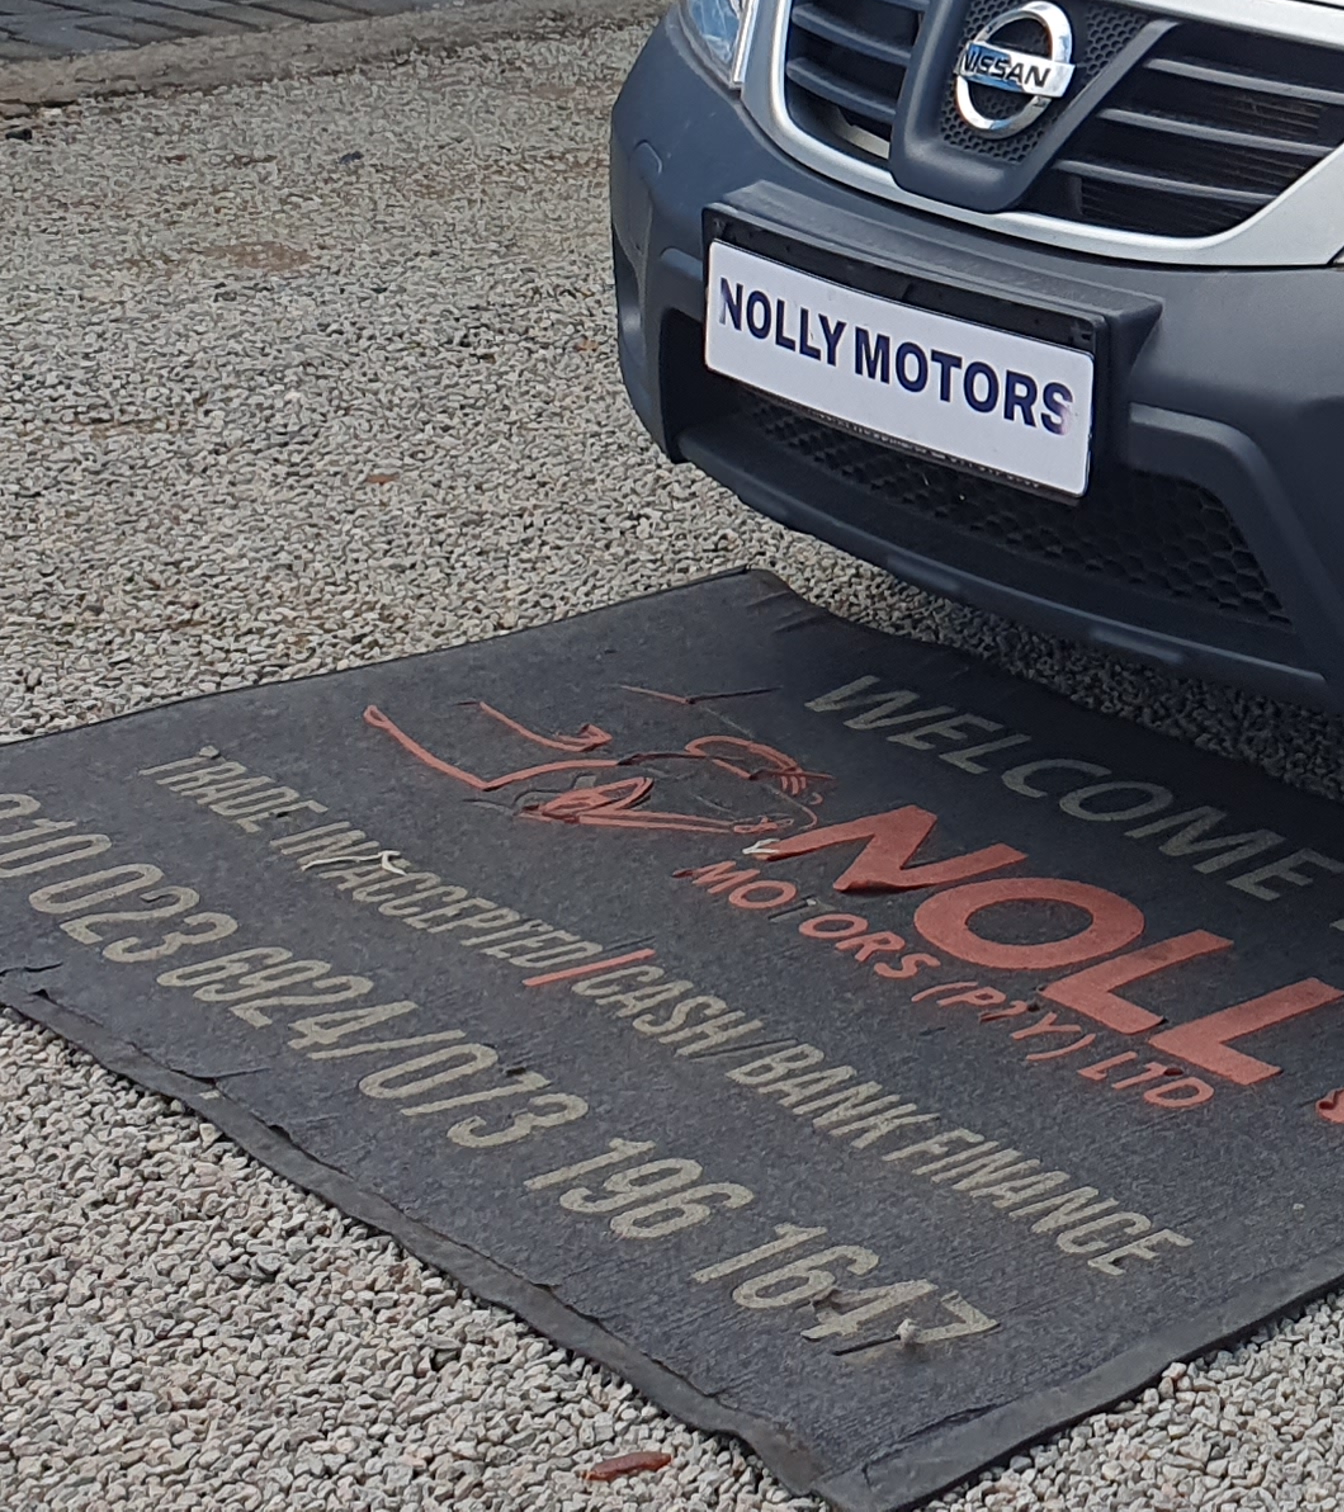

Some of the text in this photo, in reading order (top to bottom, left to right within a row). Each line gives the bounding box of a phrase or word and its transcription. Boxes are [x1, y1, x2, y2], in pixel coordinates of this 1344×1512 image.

[961, 48, 1052, 89] NISSAN
[718, 276, 1074, 437] NOLLY MOTORS
[138, 745, 329, 833] TRADE
[882, 1126, 1194, 1276] FINANCE
[1077, 1050, 1215, 1109] LTD
[524, 1136, 755, 1240] 196
[689, 1222, 1001, 1346] 1647
